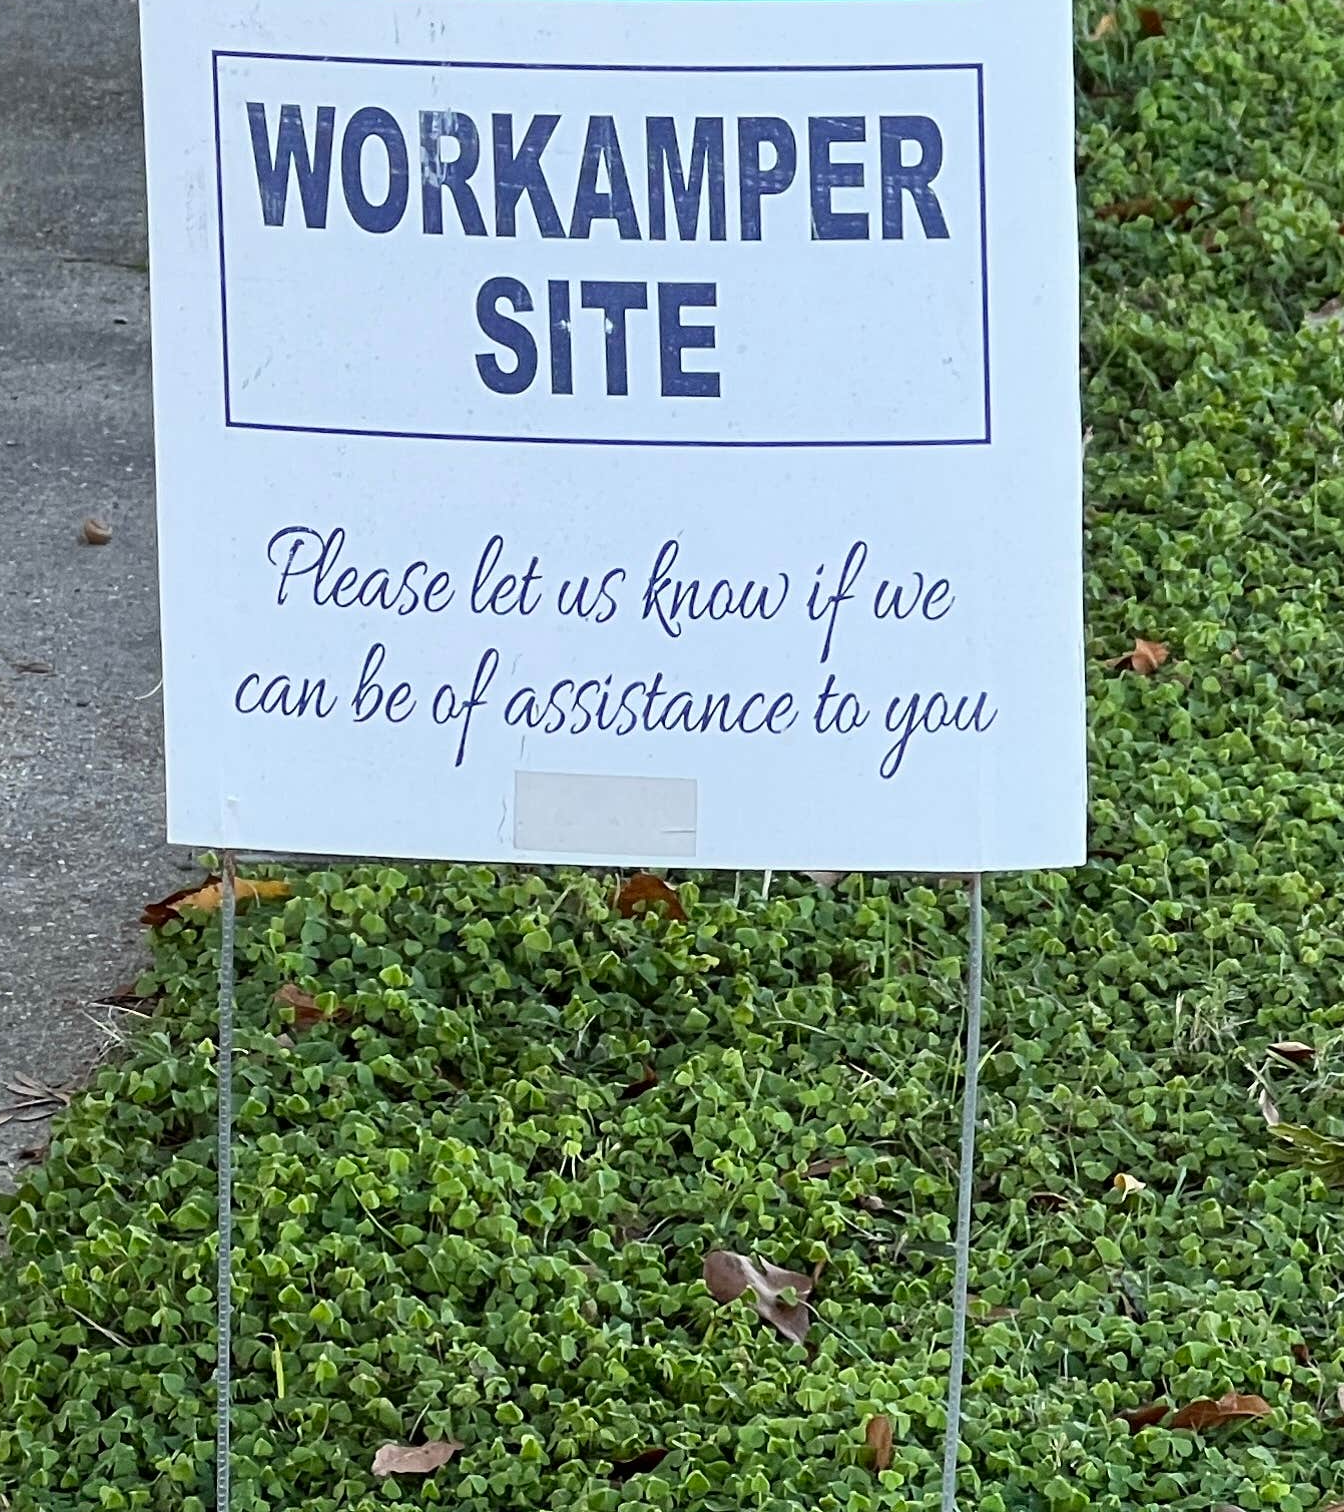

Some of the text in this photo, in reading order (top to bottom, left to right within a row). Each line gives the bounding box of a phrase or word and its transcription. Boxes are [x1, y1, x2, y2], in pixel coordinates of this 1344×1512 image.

[246, 101, 951, 242] WORKAMPER
[475, 276, 721, 399] SITE
[267, 525, 956, 664] Please let us know if we
[234, 643, 999, 779] can be of assistance to you
